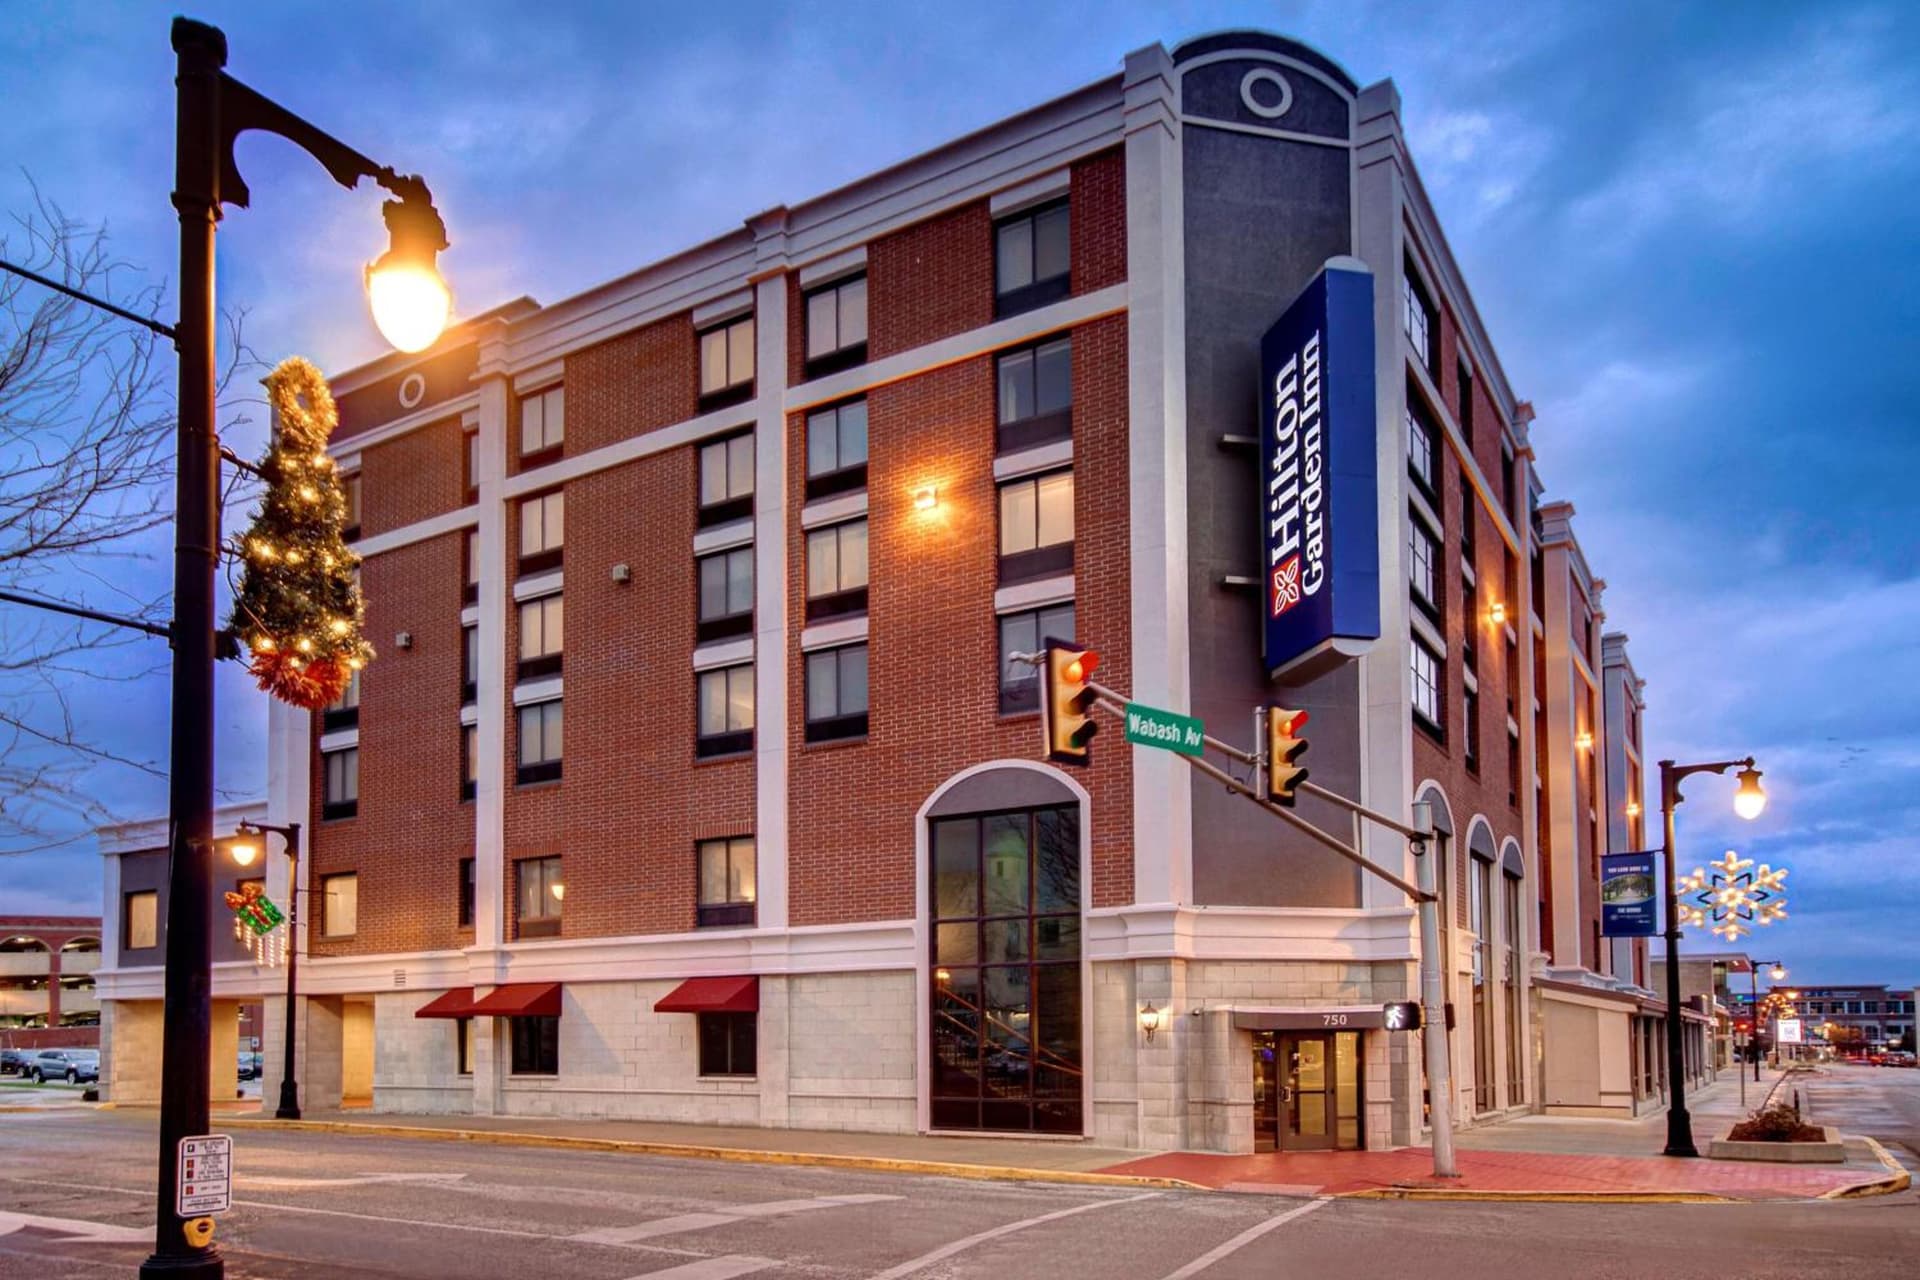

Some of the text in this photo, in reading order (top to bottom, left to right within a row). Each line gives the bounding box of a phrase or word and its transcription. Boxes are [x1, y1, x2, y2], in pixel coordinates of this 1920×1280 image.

[1272, 353, 1300, 566] Hilton
[1300, 329, 1324, 597] Garden Inn
[1128, 713, 1202, 747] Wabash Av
[1323, 1014, 1347, 1026] 750
